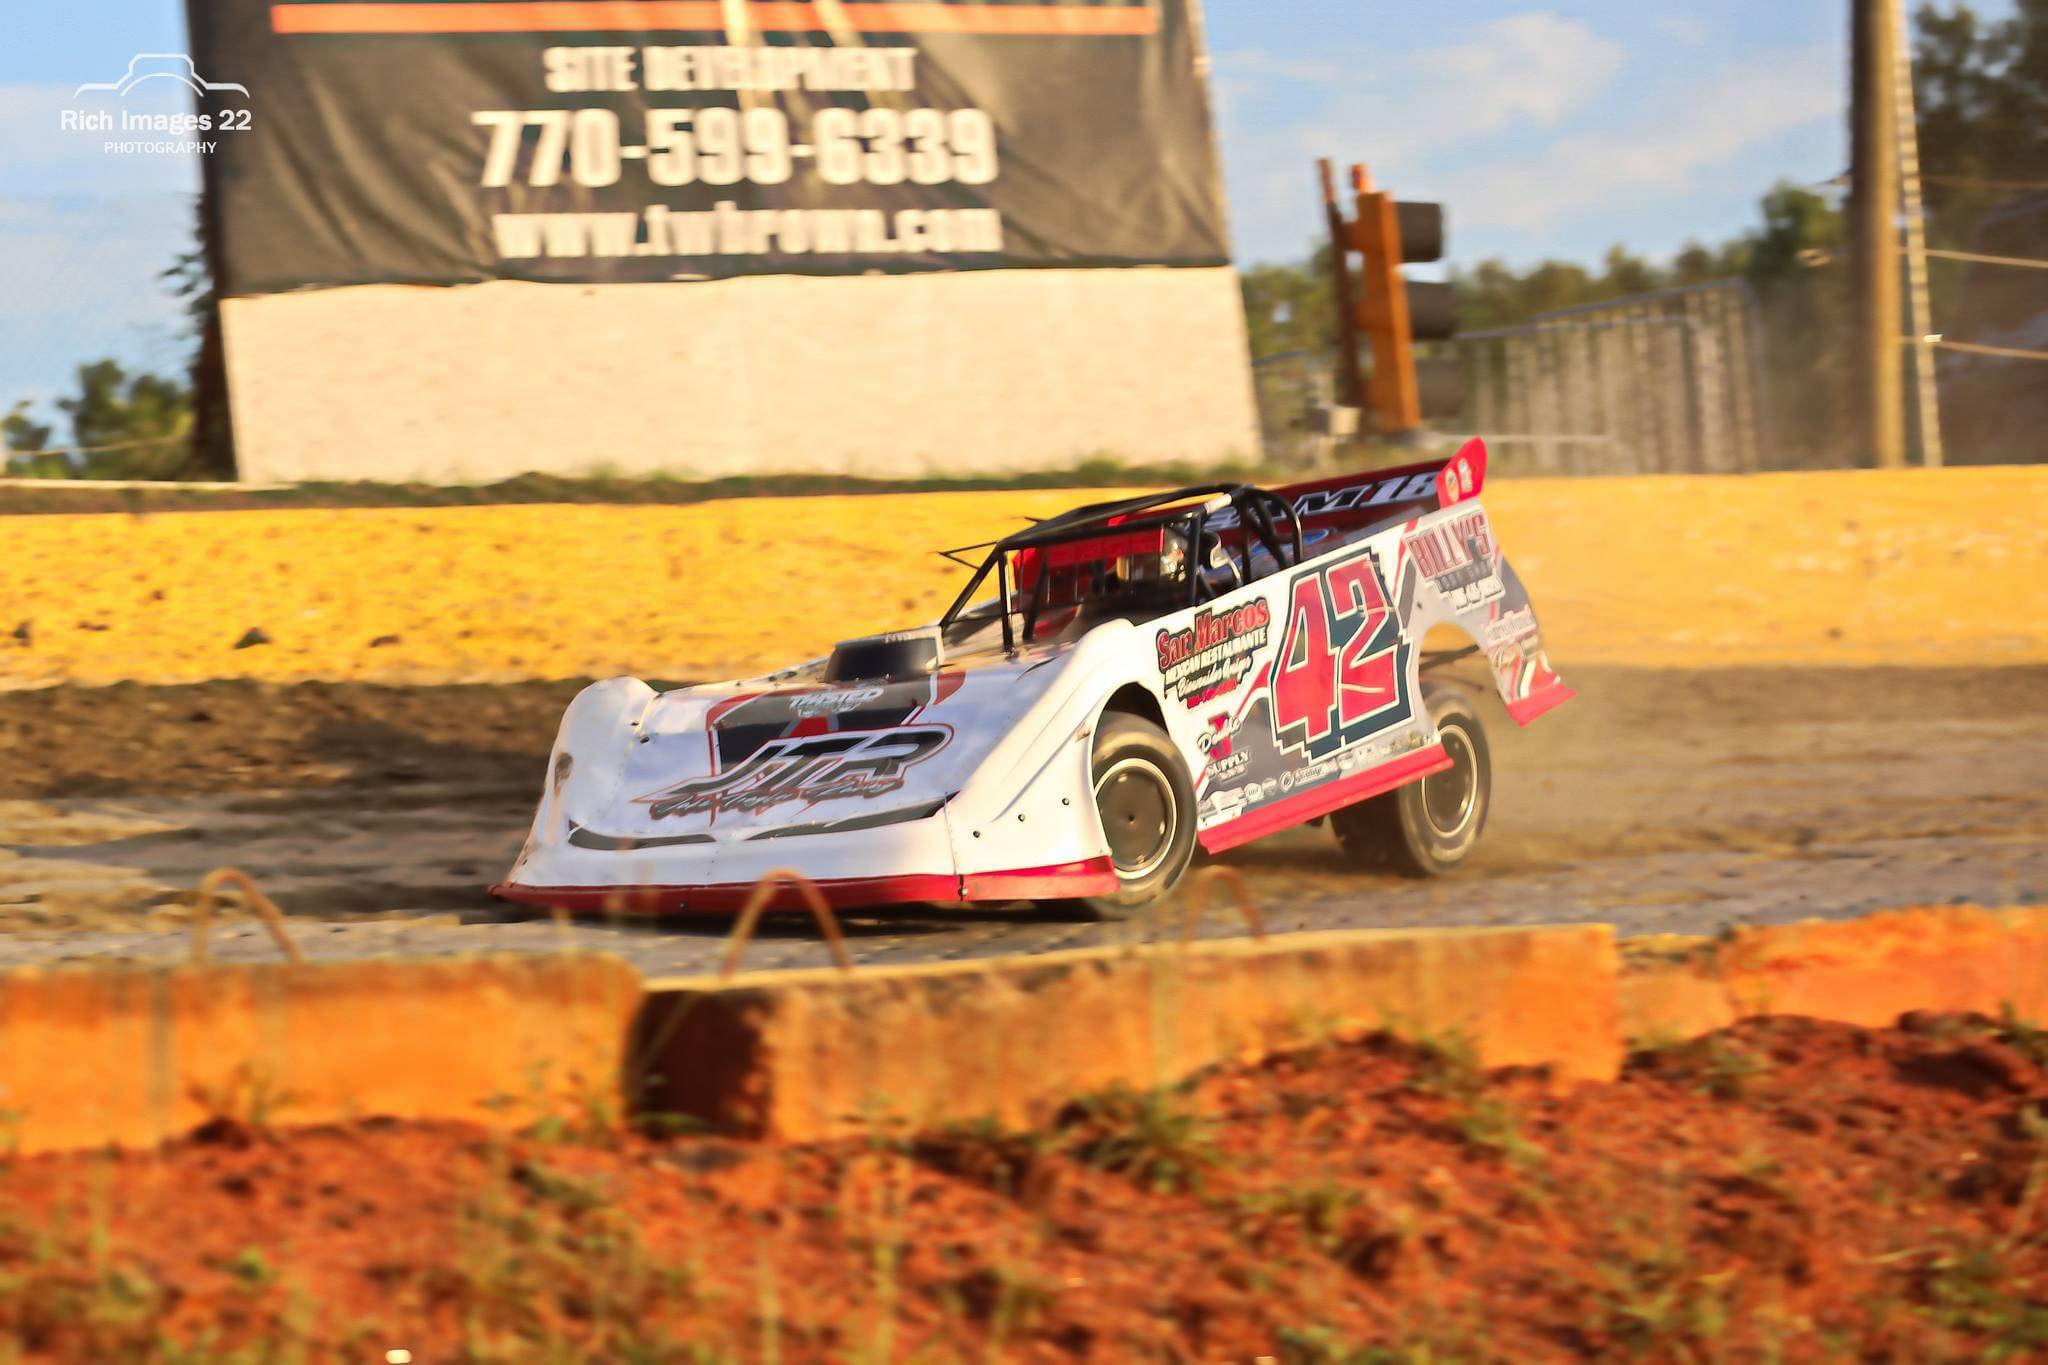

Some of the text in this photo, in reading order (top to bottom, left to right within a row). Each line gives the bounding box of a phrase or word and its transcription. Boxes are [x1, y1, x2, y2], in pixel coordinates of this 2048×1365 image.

[543, 45, 918, 92] SITE DEVELOPMENT
[471, 106, 999, 188] 770-599-6339
[1406, 511, 1494, 581] BILLY'S
[1193, 598, 1269, 653] Marcos
[1273, 550, 1401, 745] 42
